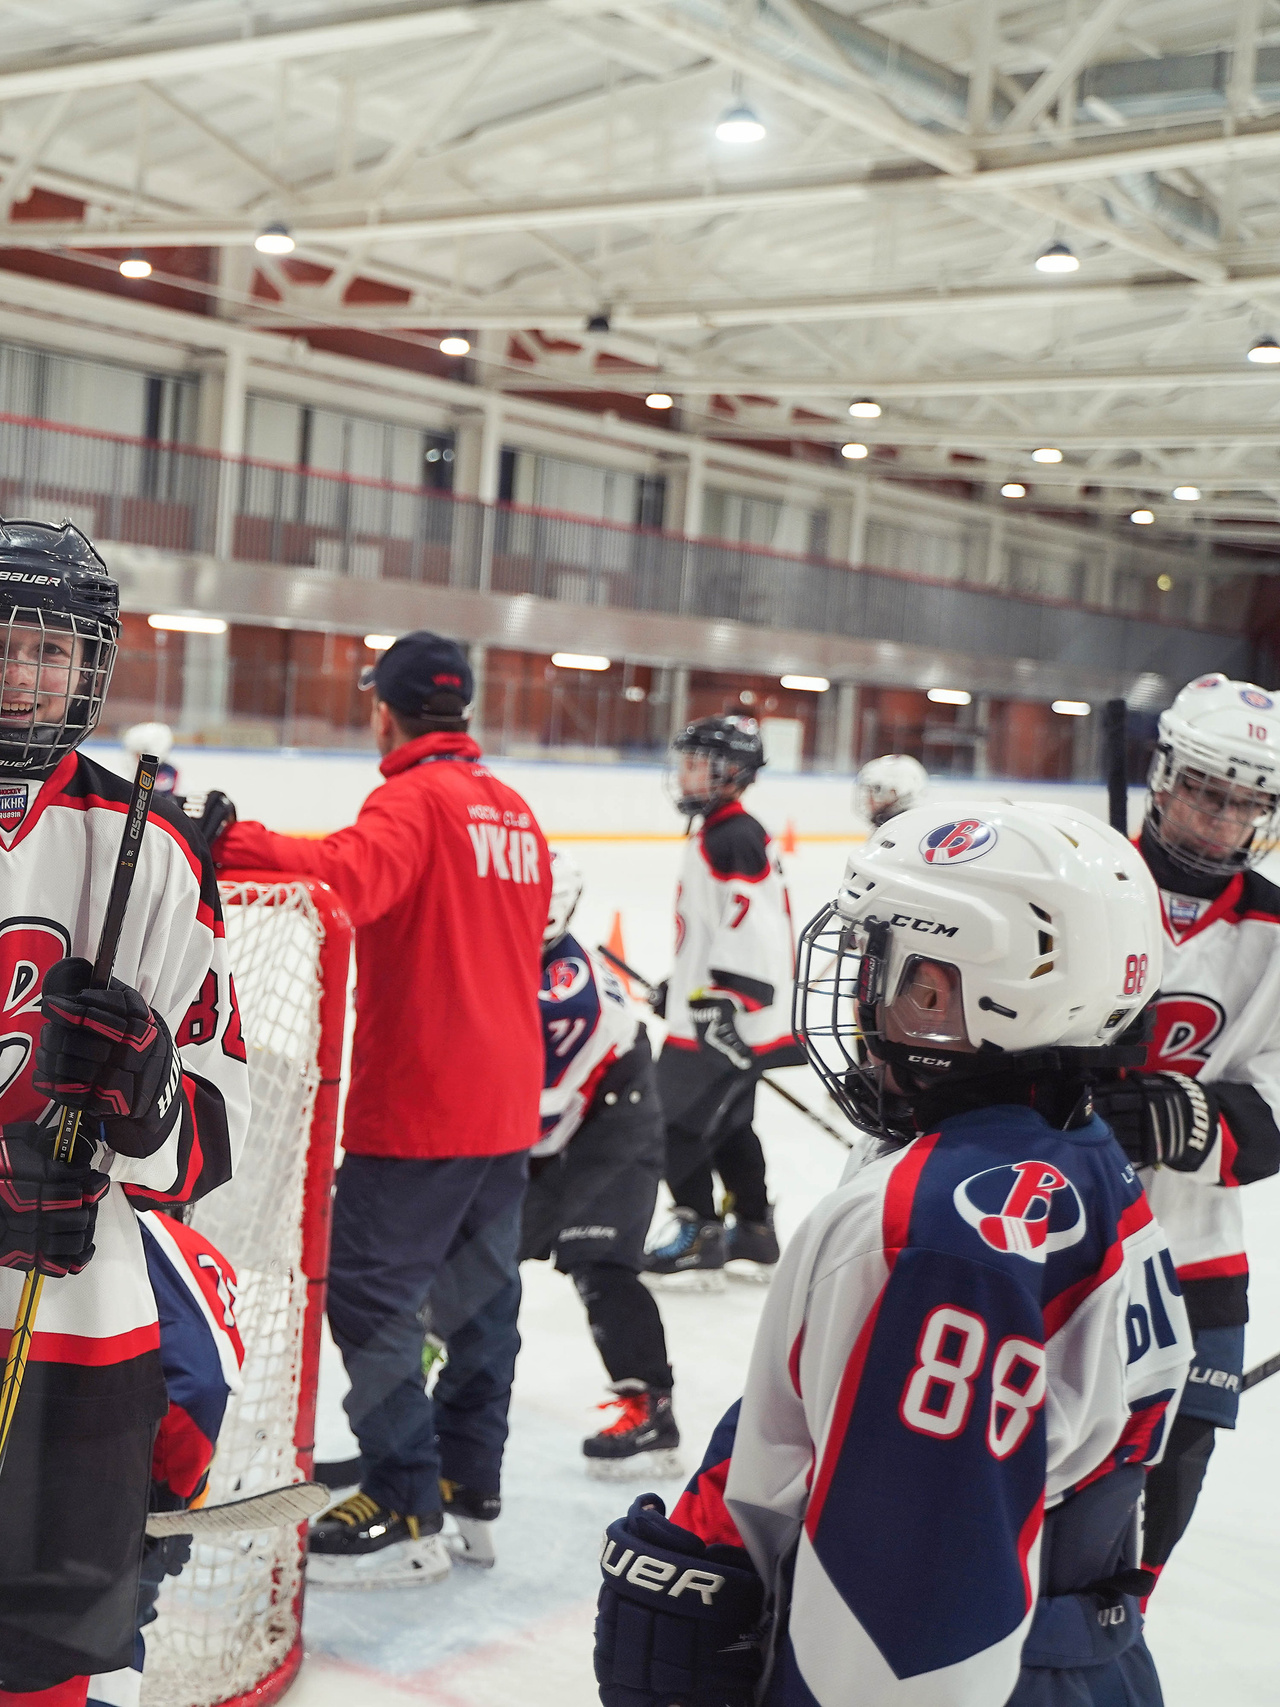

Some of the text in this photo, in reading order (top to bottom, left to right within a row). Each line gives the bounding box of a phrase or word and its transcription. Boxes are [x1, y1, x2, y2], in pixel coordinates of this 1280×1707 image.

[1248, 722, 1267, 741] 10
[890, 913, 960, 938] CCM
[1123, 953, 1148, 995] 88
[907, 1054, 952, 1068] CCM
[898, 1303, 1047, 1462] 88
